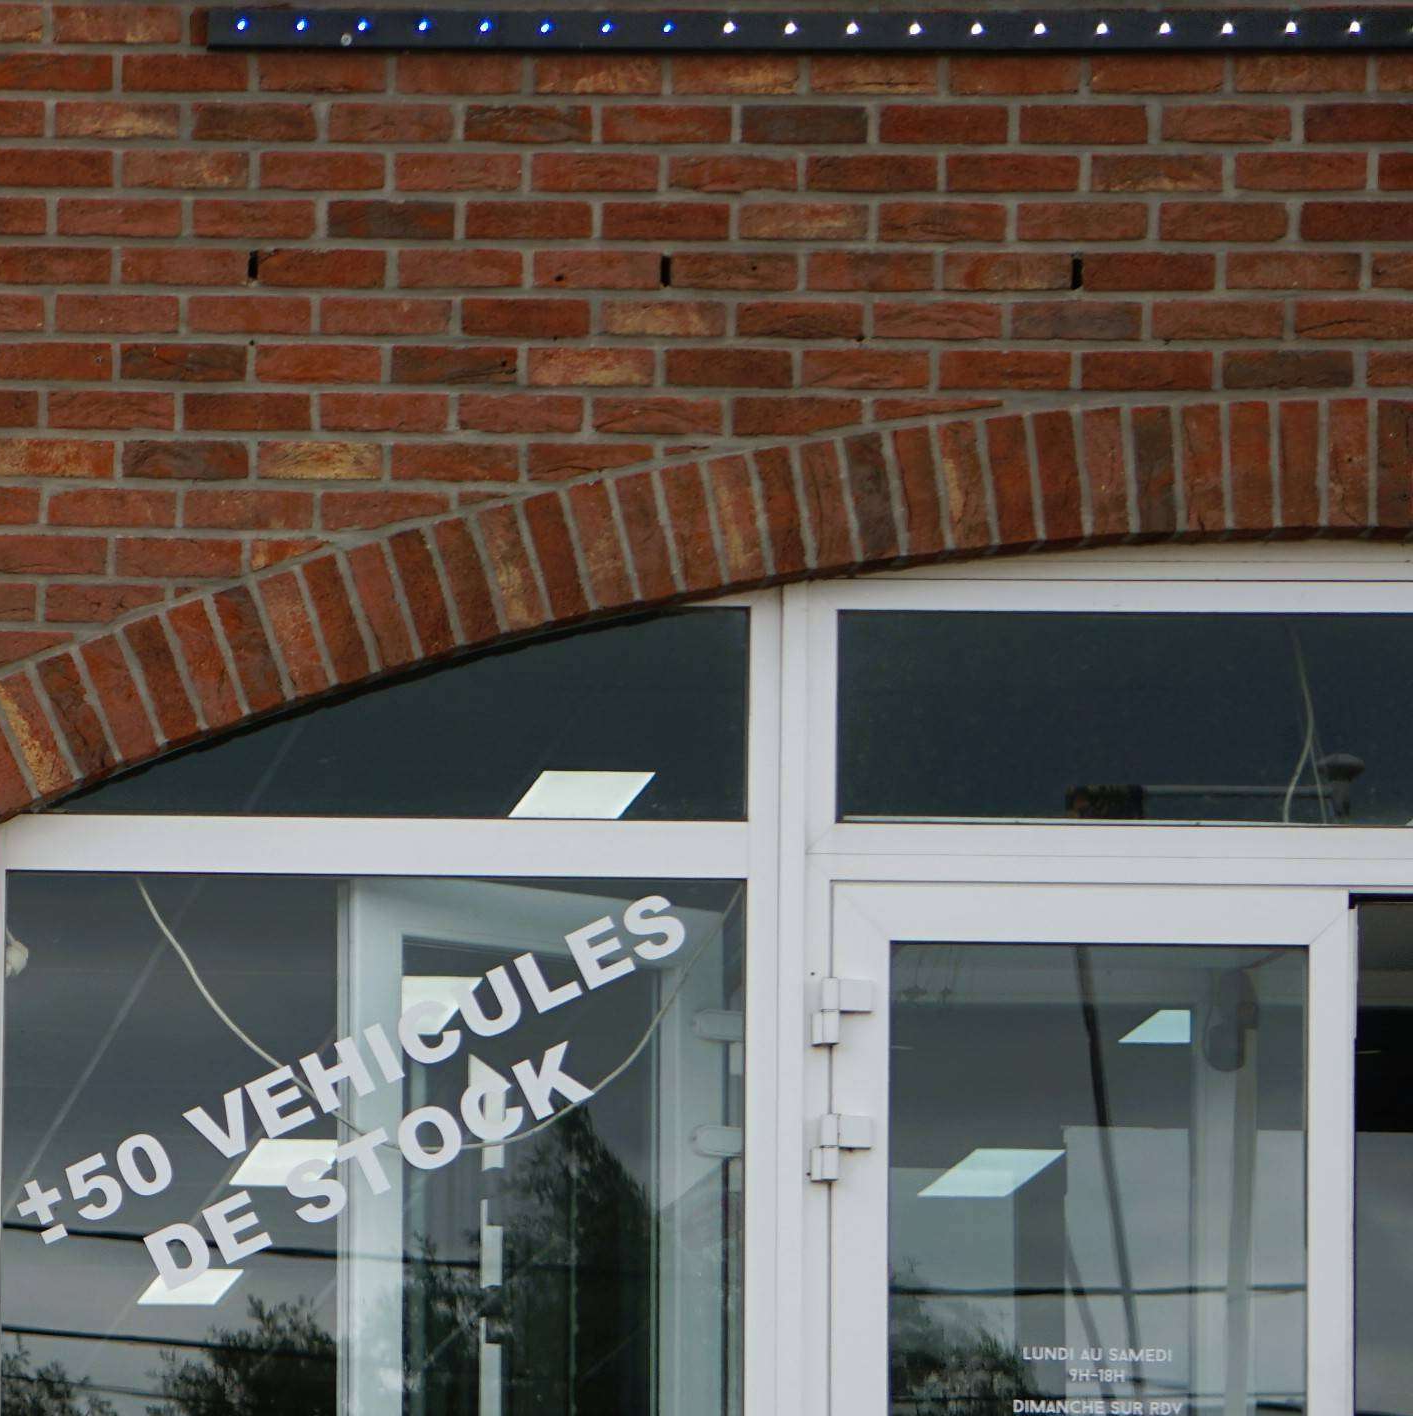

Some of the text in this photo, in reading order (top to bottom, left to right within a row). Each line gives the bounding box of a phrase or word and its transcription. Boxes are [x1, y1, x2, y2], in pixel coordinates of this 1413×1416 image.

[182, 895, 685, 1159] VEHICULES
[143, 1041, 594, 1290] DE STOCK
[1023, 1347, 1173, 1362] LUNDI AU SAMEDI
[1069, 1368, 1126, 1383] 9H-18H
[1013, 1399, 1183, 1415] DIMANCHE SUR RDV
